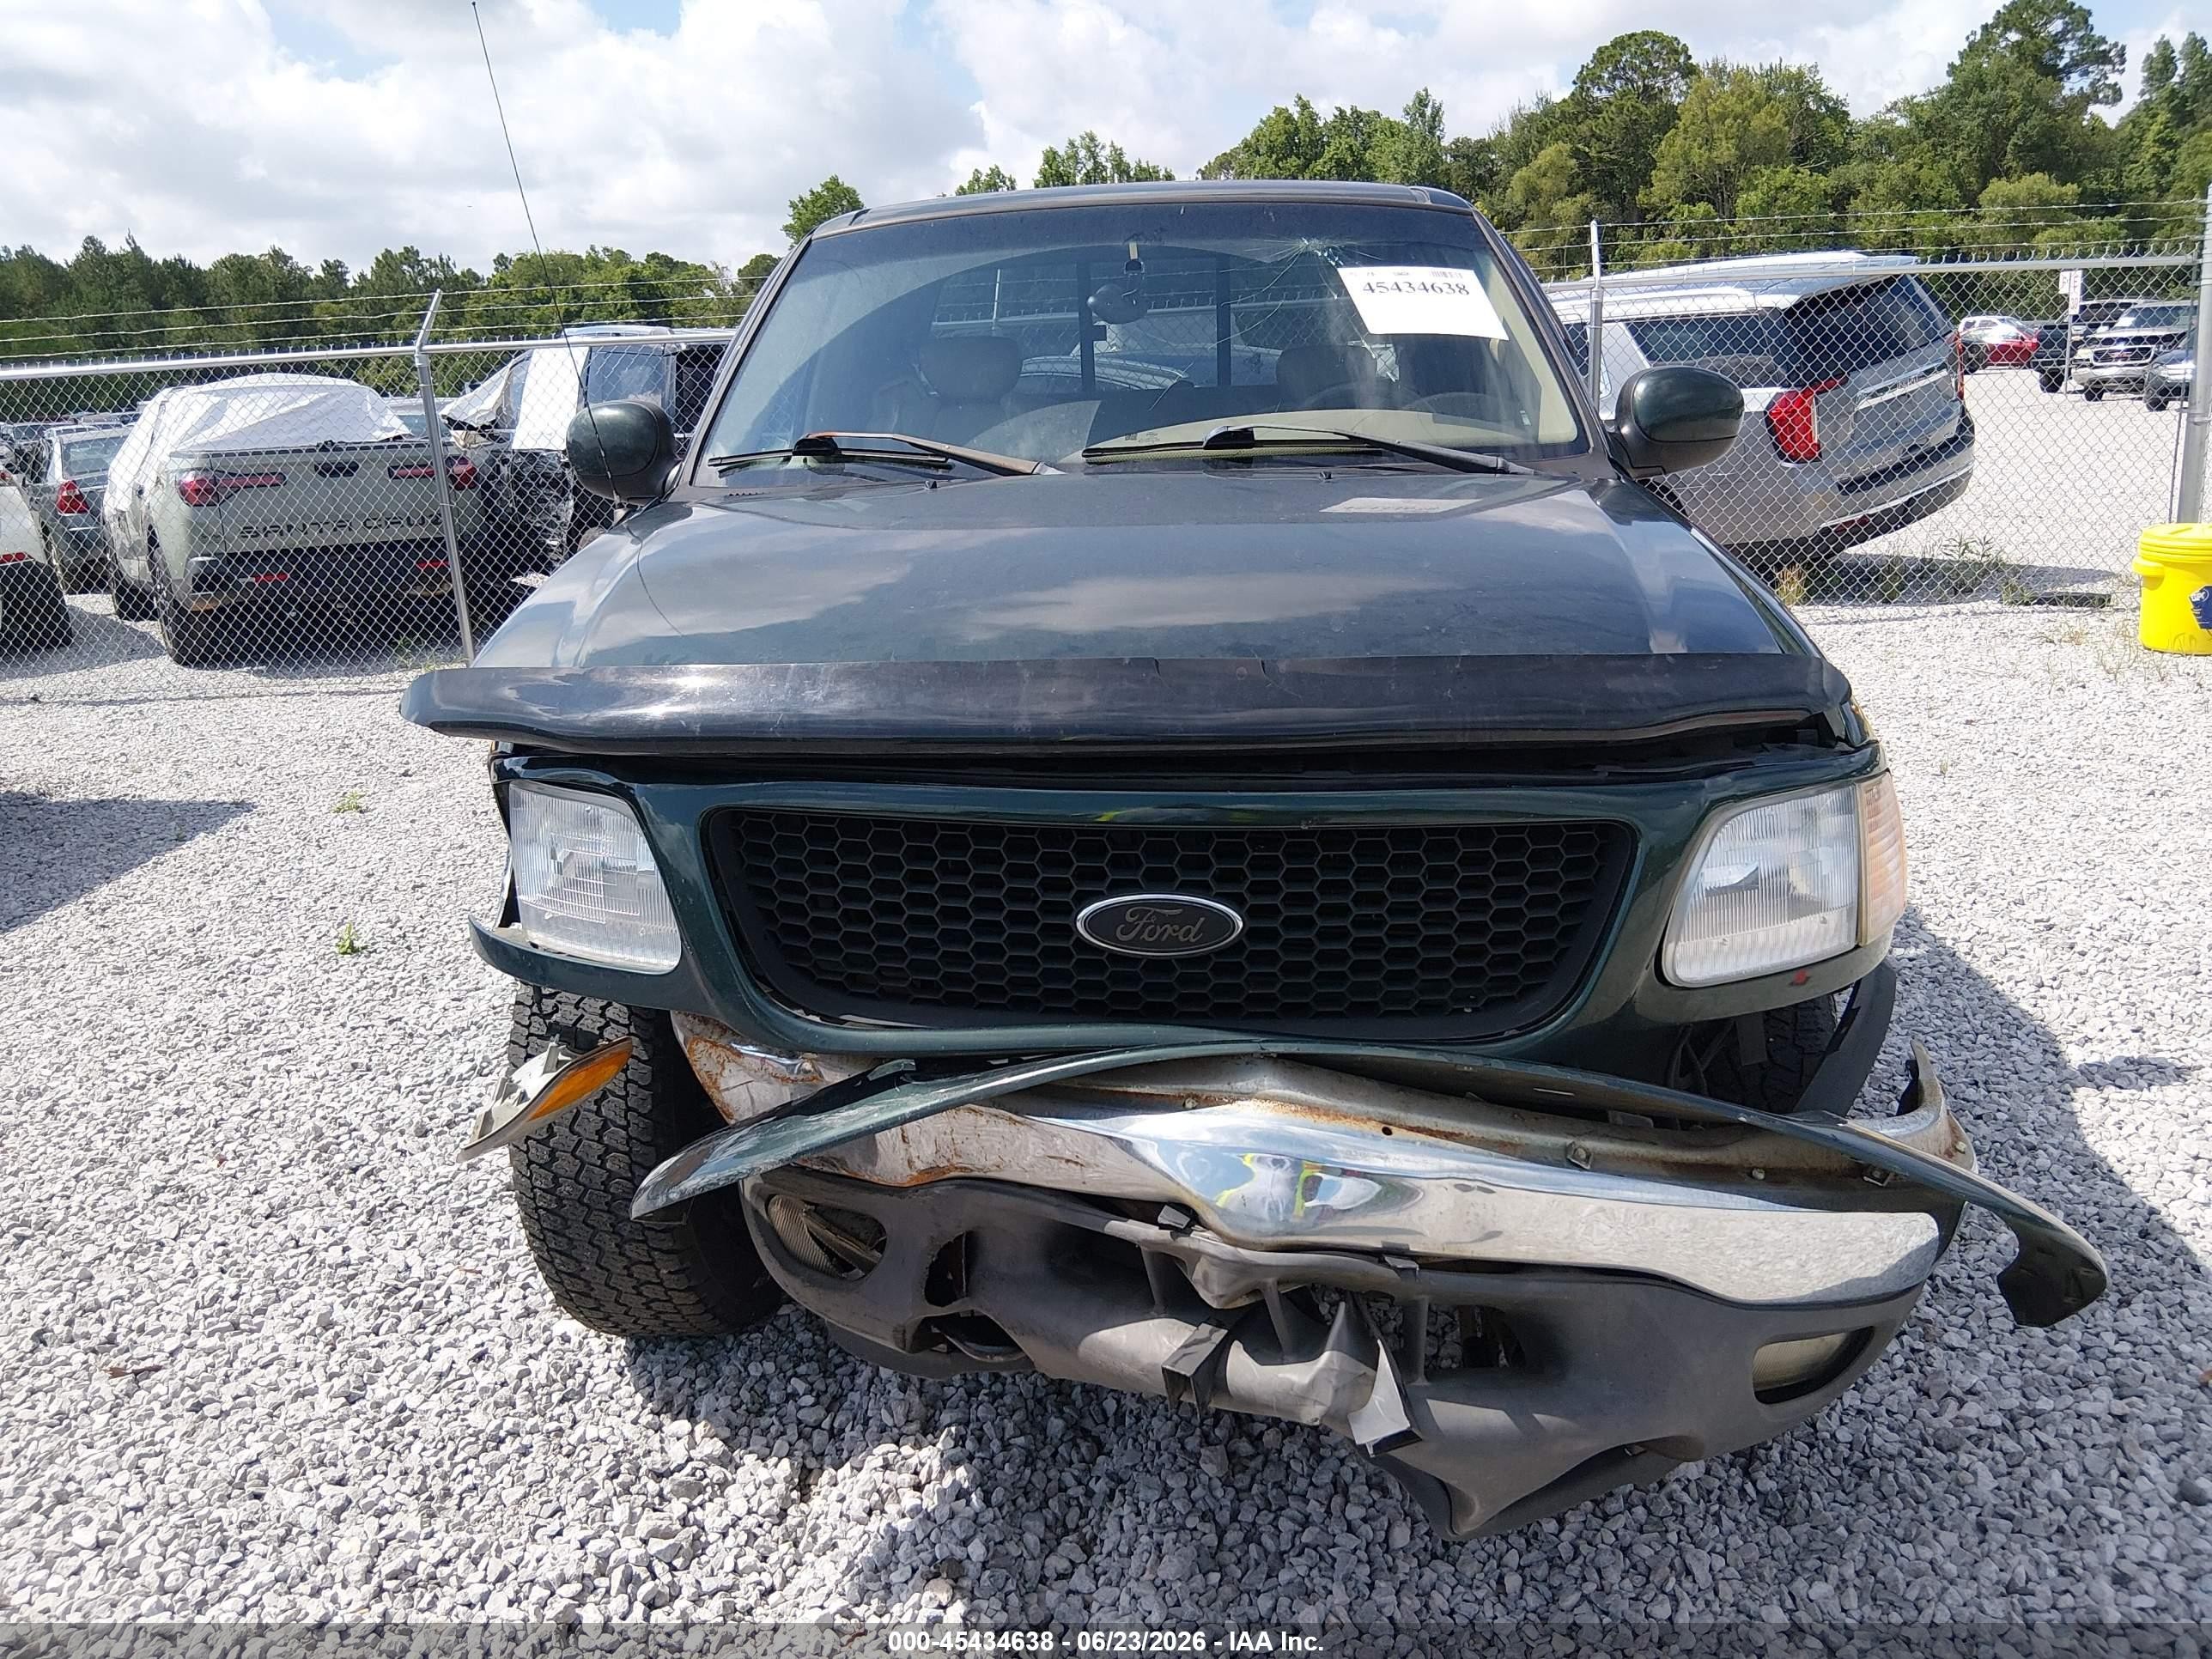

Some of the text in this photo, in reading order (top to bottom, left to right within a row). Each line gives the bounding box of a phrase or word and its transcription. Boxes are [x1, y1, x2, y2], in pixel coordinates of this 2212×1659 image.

[1363, 282, 1469, 295] 45434638
[239, 519, 353, 538] SANTA
[1116, 906, 1204, 943] Ford
